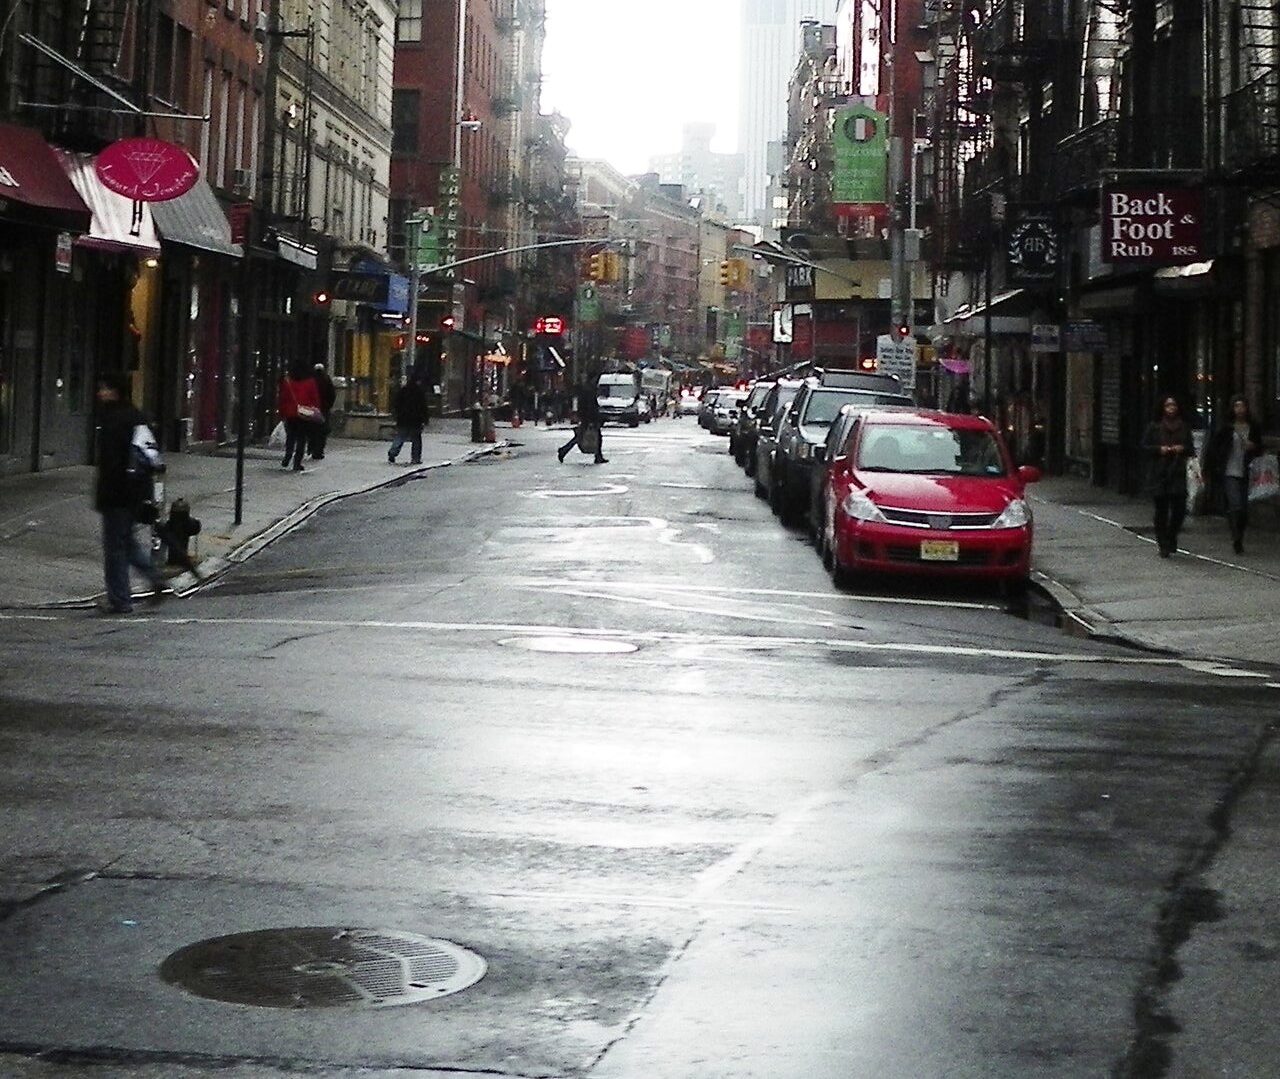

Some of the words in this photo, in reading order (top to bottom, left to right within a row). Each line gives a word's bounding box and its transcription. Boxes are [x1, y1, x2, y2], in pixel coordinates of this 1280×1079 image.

[1110, 193, 1175, 216] Back
[1111, 217, 1175, 240] Foot
[1180, 214, 1195, 224] &
[1111, 242, 1154, 257] Rub
[1172, 246, 1198, 256] 185
